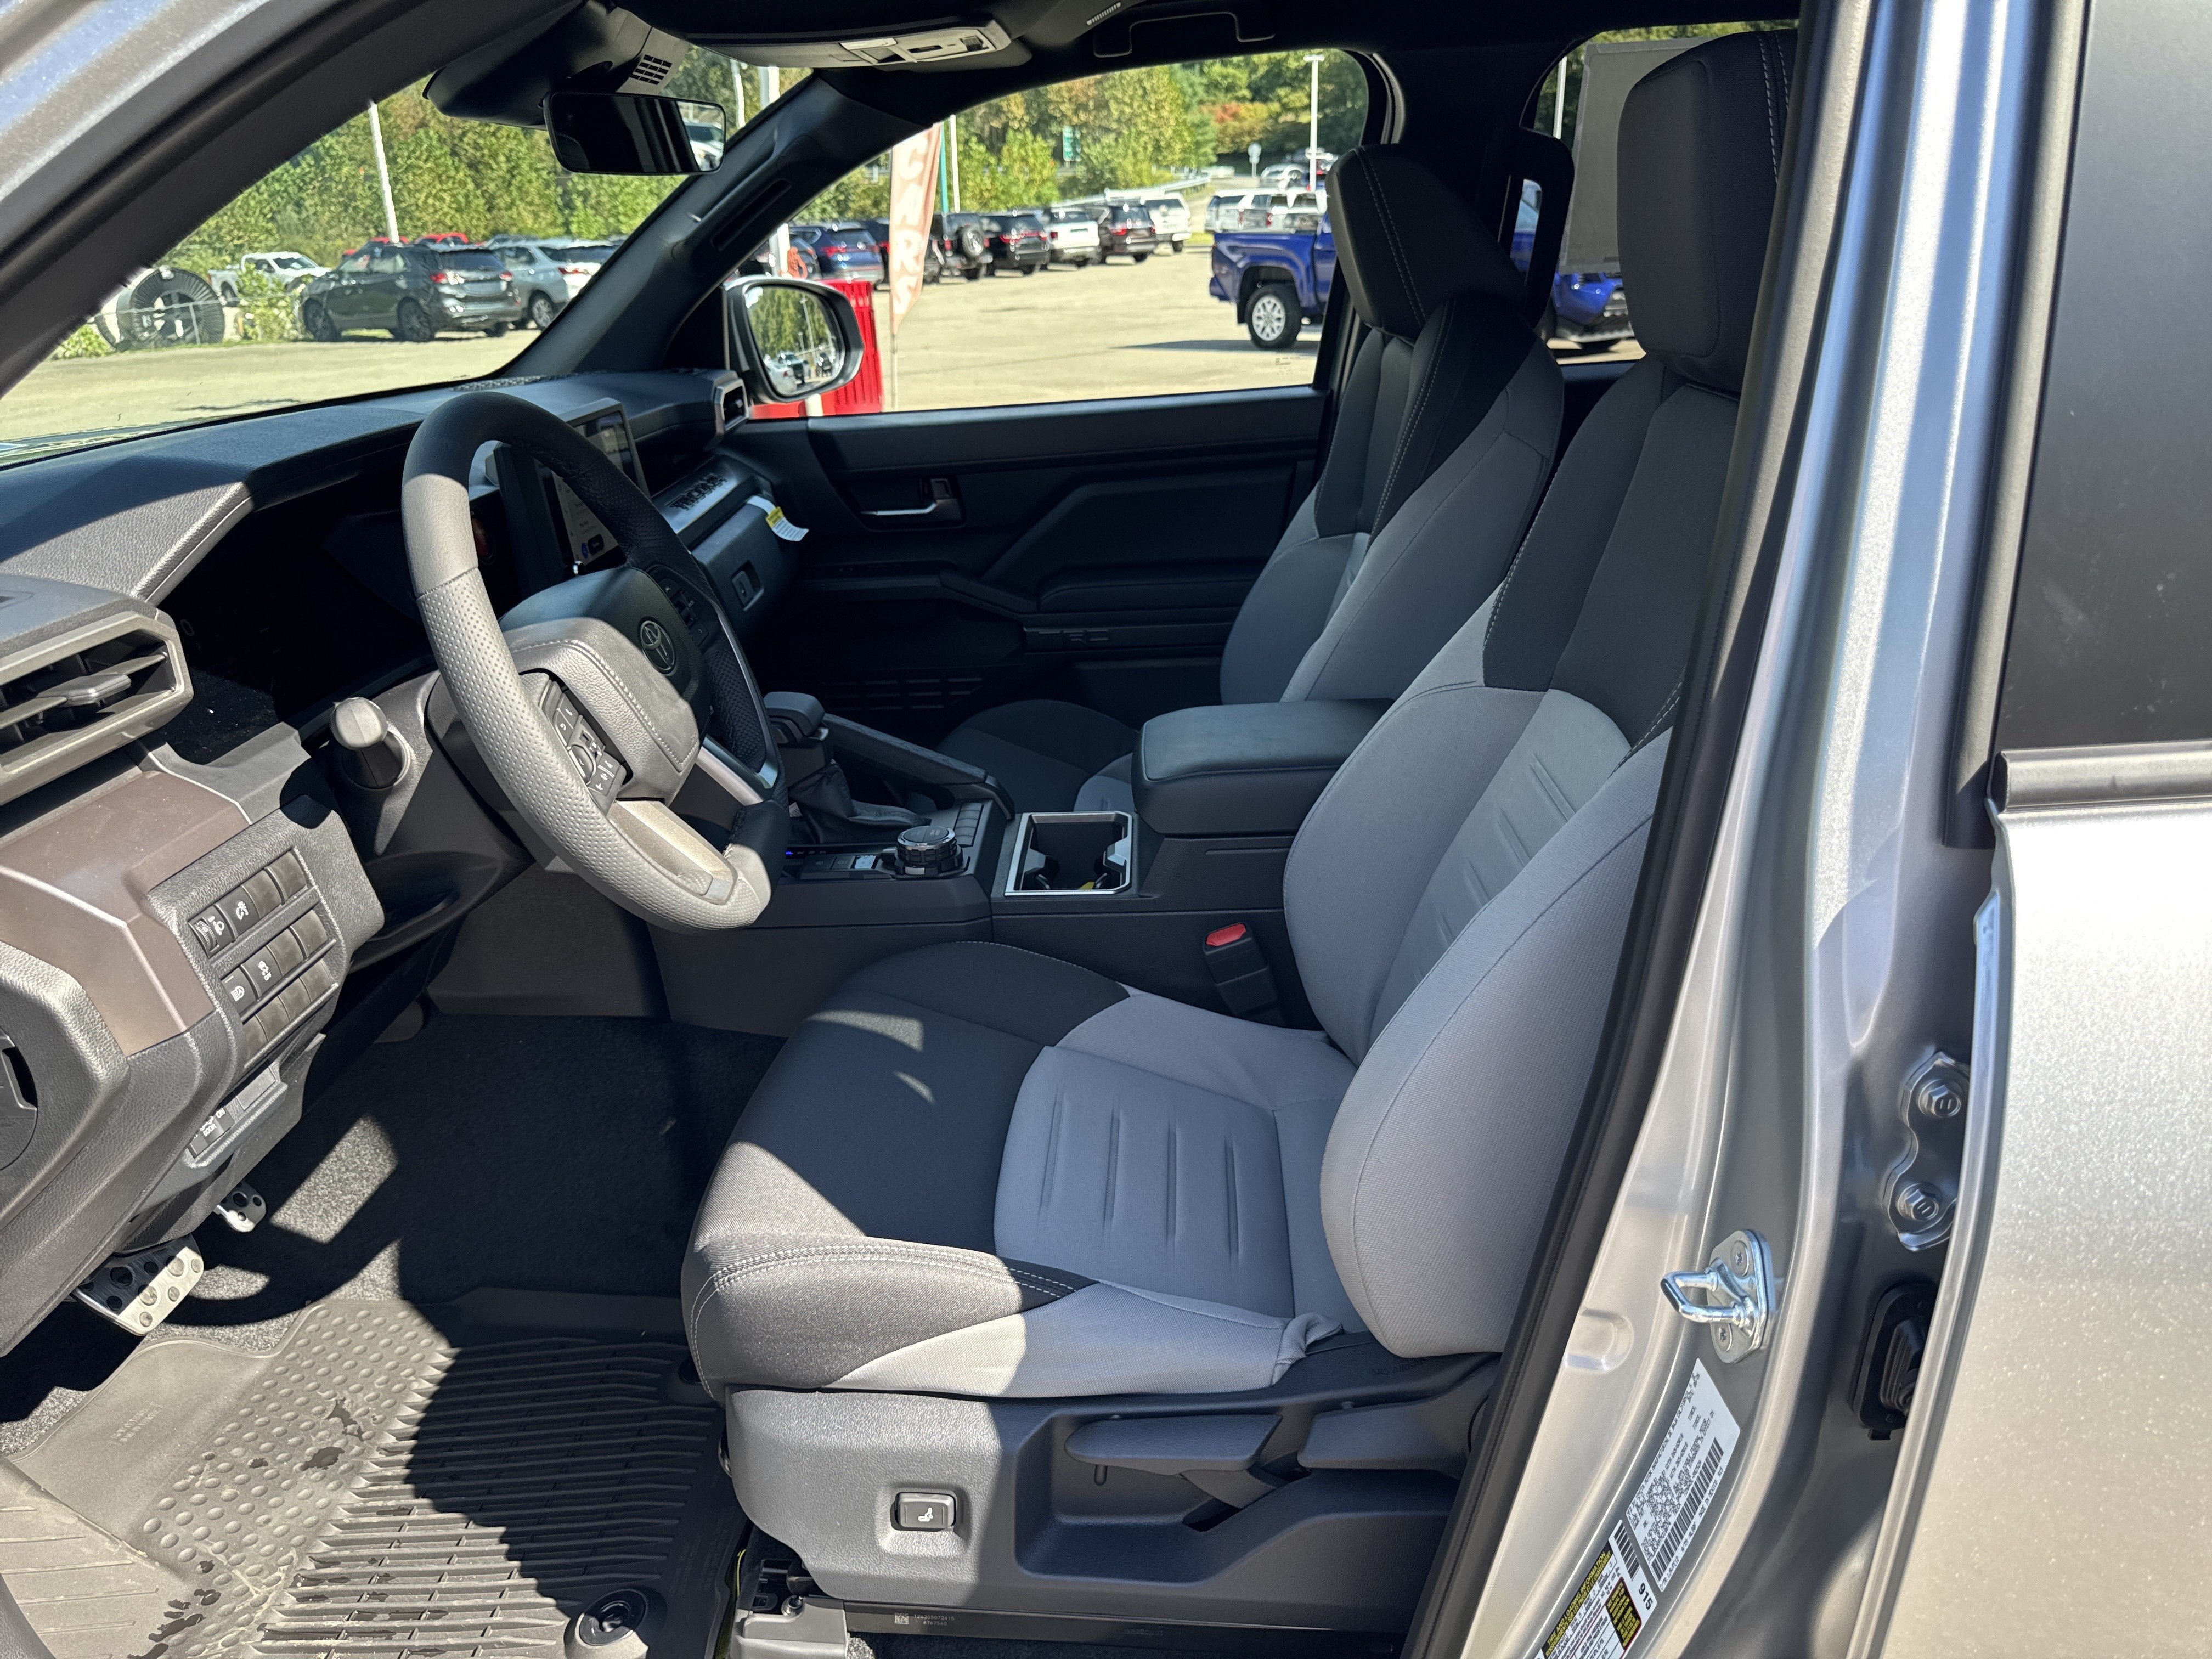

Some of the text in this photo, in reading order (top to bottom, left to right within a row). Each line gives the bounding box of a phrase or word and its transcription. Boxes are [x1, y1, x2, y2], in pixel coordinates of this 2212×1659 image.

[1556, 1617, 1565, 1633] AND
[1580, 1550, 1605, 1594] INFORMATION
[1638, 1582, 1653, 1610] 915
